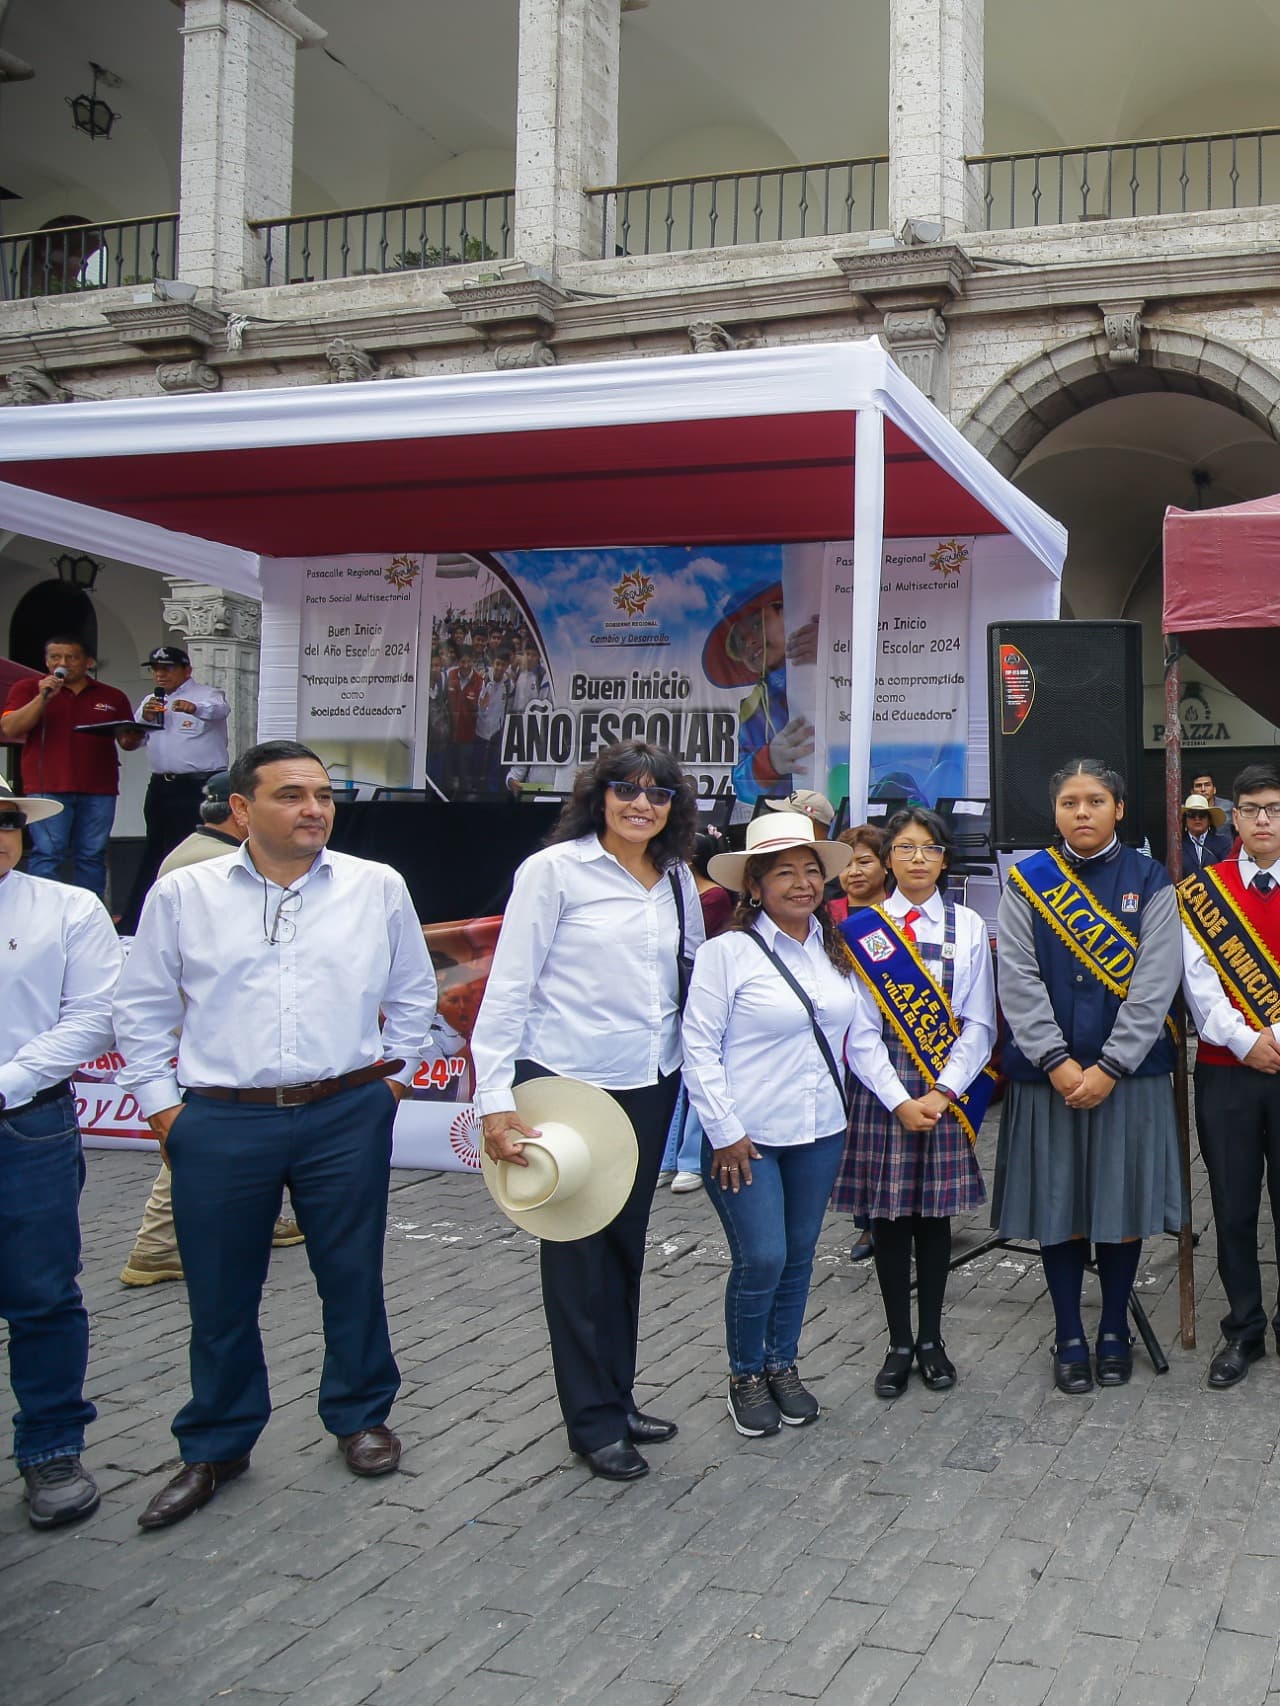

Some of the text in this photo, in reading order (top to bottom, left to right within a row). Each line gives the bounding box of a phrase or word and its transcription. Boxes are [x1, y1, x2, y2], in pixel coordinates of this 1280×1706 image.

[885, 553, 926, 567] Regional
[306, 568, 344, 579] Pasacalle
[347, 567, 382, 579] Regional
[895, 579, 959, 592] Multisectorial
[306, 591, 411, 604] Pacto Social Multisectorial
[893, 616, 927, 630] Inicio
[328, 623, 383, 638] Buen Inicio
[590, 634, 619, 644] Cambio
[628, 633, 670, 643] Desarrollo
[832, 637, 961, 654] del Escolar 2024
[304, 642, 410, 658] del Año Escolar 2024
[571, 670, 690, 700] Buen inicio
[887, 673, 965, 687] comprometida
[876, 693, 906, 703] como
[310, 705, 351, 717] Sociedad
[503, 703, 736, 764] AÑO ESCOLAR
[1041, 881, 1135, 978] ALCALD
[903, 1011, 917, 1028] EL
